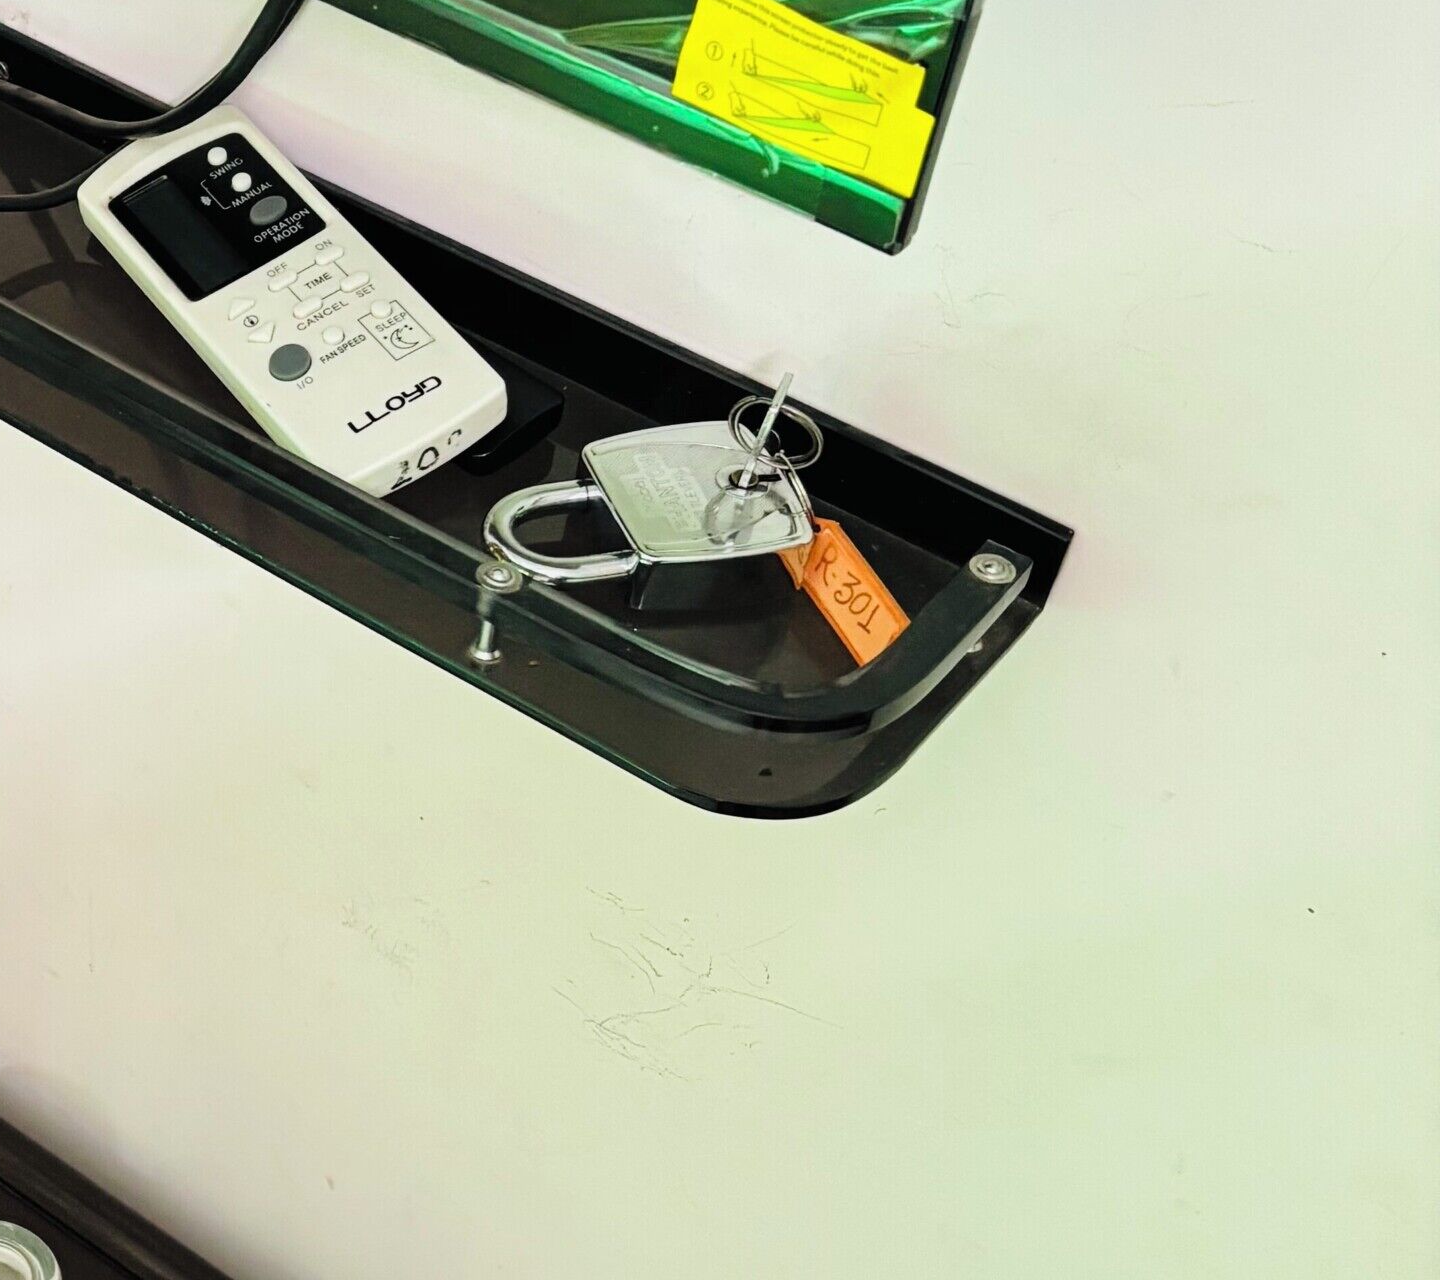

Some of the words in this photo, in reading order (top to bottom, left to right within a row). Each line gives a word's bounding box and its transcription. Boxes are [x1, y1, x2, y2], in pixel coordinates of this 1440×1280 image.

[209, 157, 244, 179] SWING
[231, 181, 273, 207] MANUAL
[253, 208, 310, 243] OPERATION
[272, 221, 304, 243] MODE
[314, 239, 333, 251] ON
[266, 261, 288, 278] OFF
[304, 272, 333, 290] TIME
[355, 283, 376, 298] SET
[296, 301, 349, 331] CANCEL
[375, 312, 407, 332] SLEEP
[319, 350, 338, 364] FAN
[337, 334, 366, 354] SPEED
[347, 375, 442, 433] LLOYD
